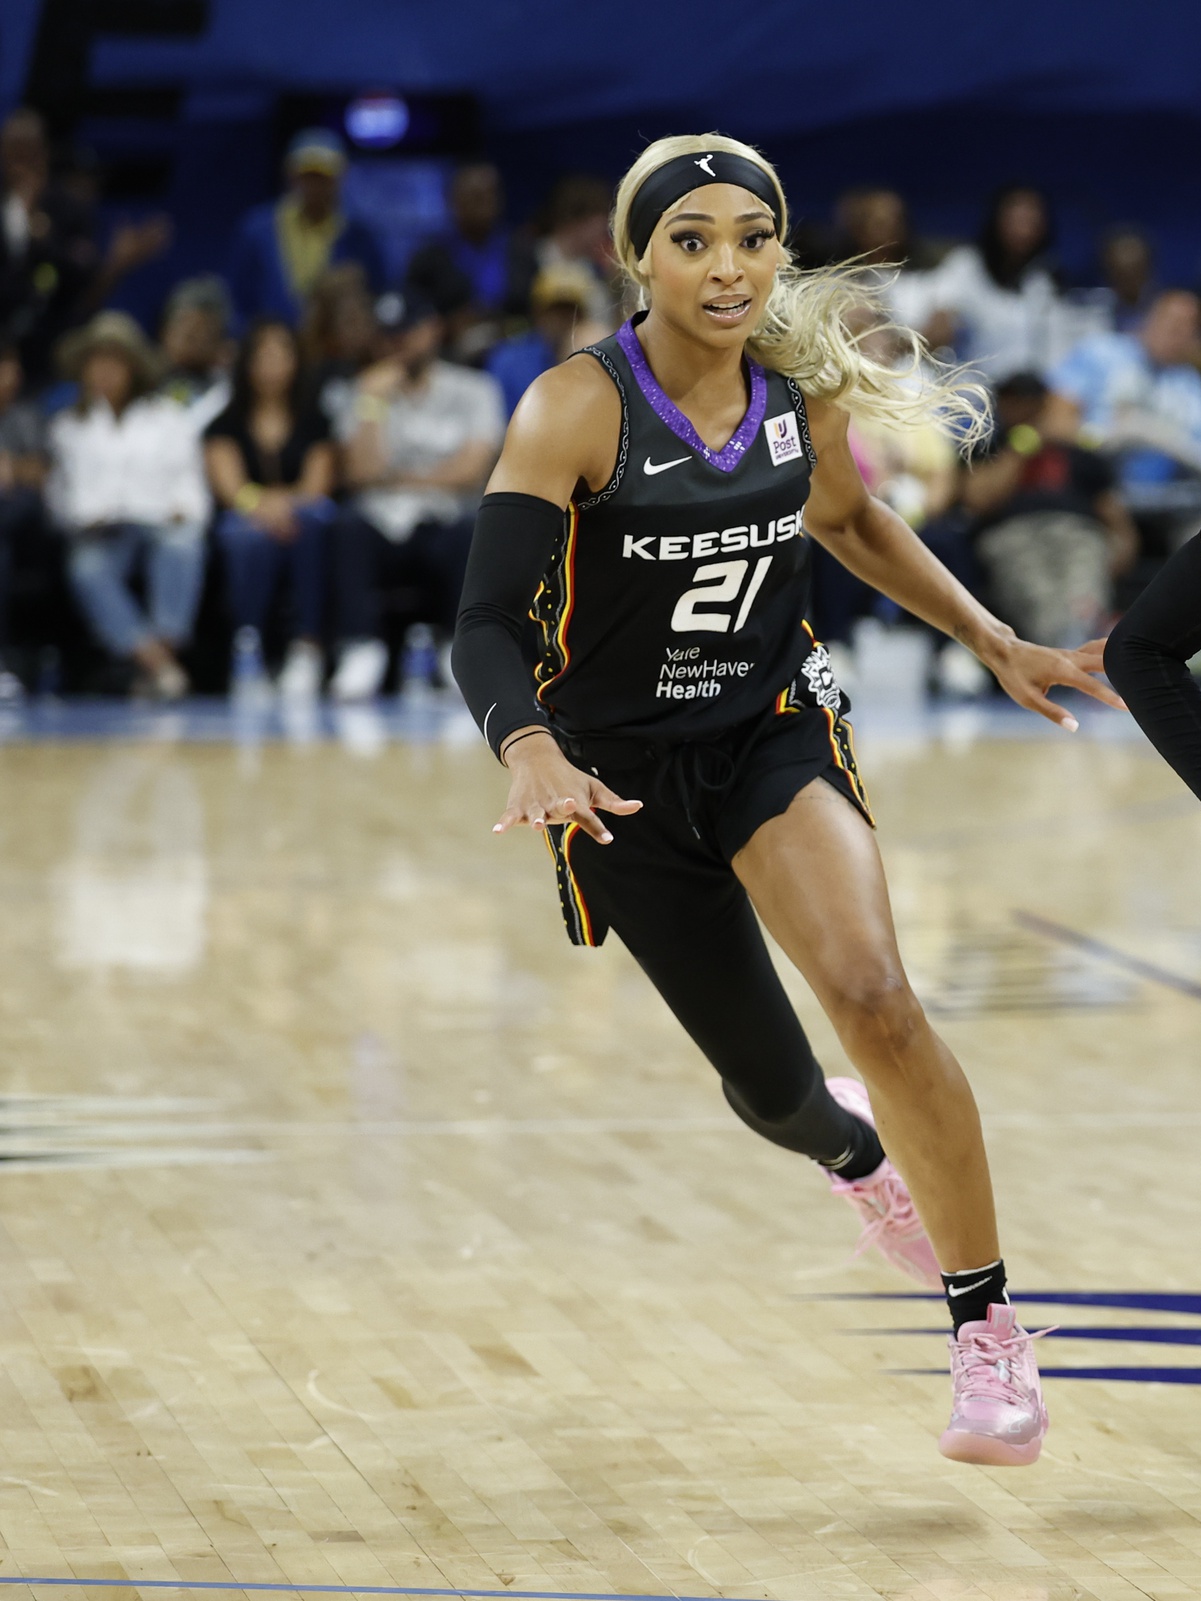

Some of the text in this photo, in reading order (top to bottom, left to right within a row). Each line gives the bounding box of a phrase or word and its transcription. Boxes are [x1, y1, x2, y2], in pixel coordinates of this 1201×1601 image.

[773, 435, 797, 454] Post
[670, 555, 774, 634] 21
[666, 646, 700, 662] Yale
[659, 659, 755, 680] NewHave
[656, 679, 721, 699] Health
